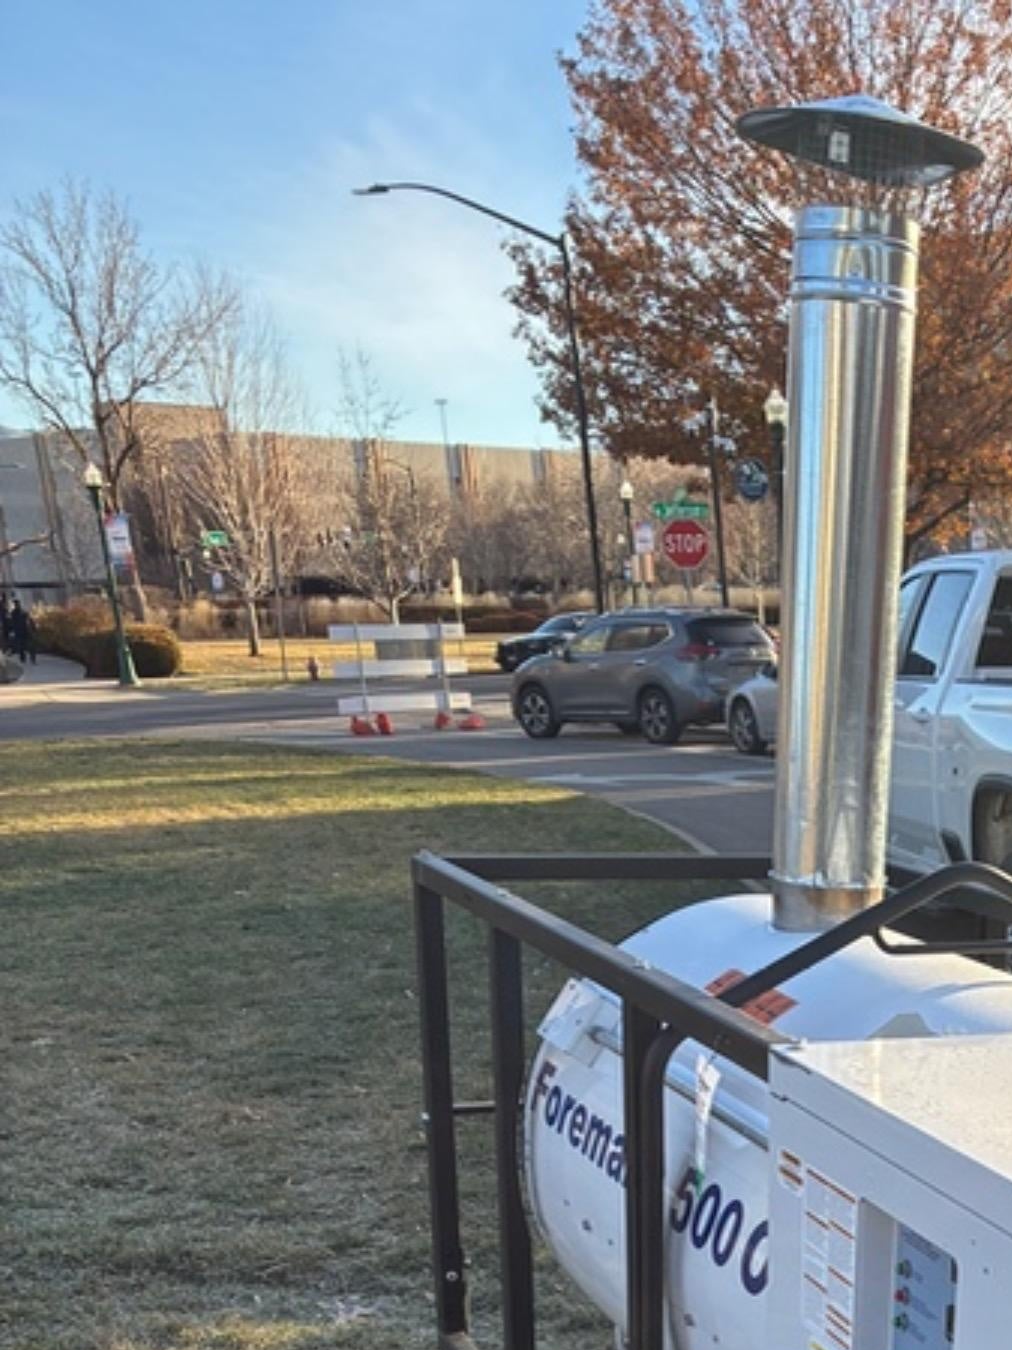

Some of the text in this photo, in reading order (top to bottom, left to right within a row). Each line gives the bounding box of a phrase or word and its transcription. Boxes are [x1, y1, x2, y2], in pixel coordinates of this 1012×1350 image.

[664, 533, 706, 553] STOP
[531, 1061, 627, 1189] Forema
[669, 1166, 744, 1267] 500
